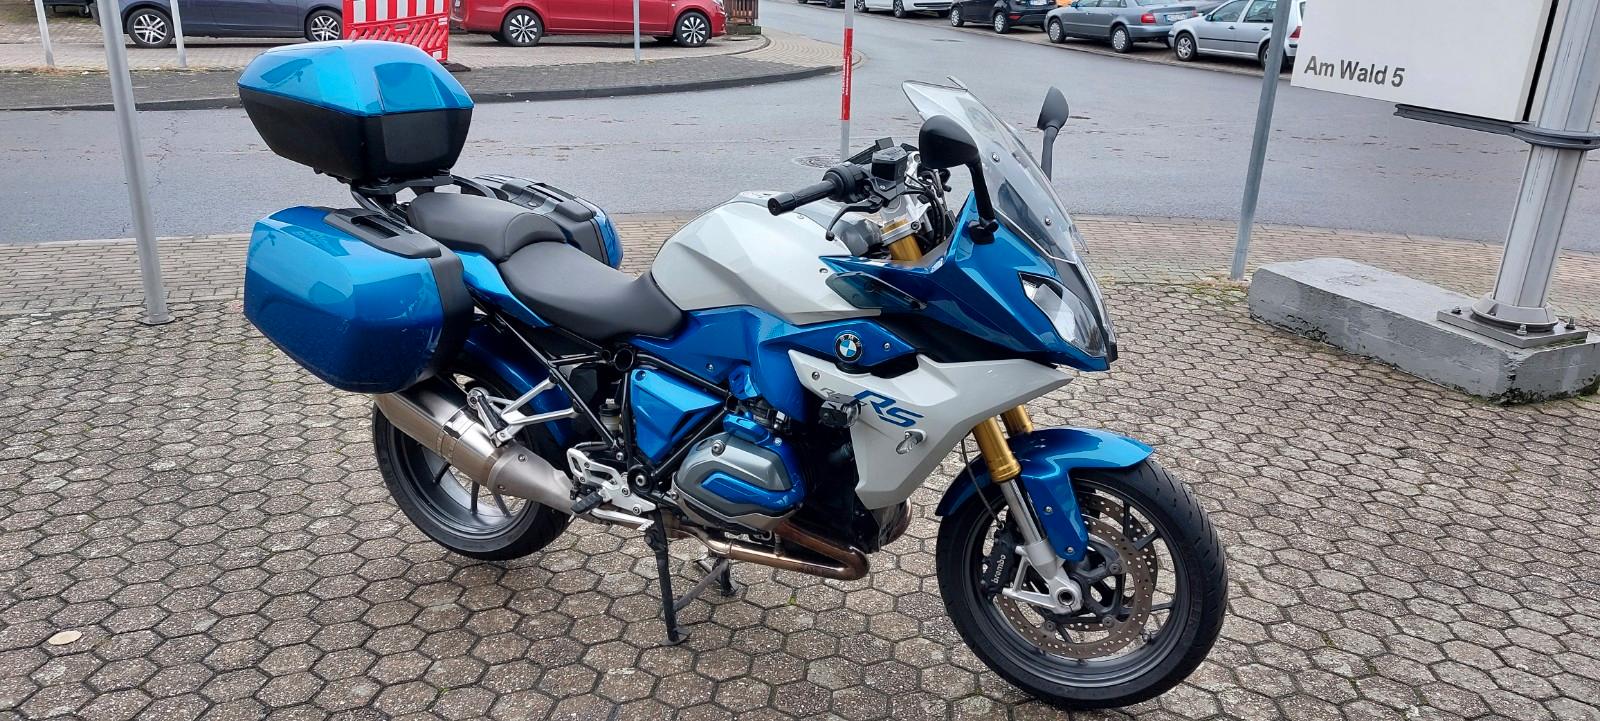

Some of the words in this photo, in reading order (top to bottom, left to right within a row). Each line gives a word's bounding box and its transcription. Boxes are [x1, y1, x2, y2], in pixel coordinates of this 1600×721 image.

[1304, 55, 1335, 77] Am
[1340, 59, 1388, 85] Wald
[1391, 67, 1406, 88] 5
[854, 389, 925, 428] RS
[990, 554, 1007, 584] brembo
